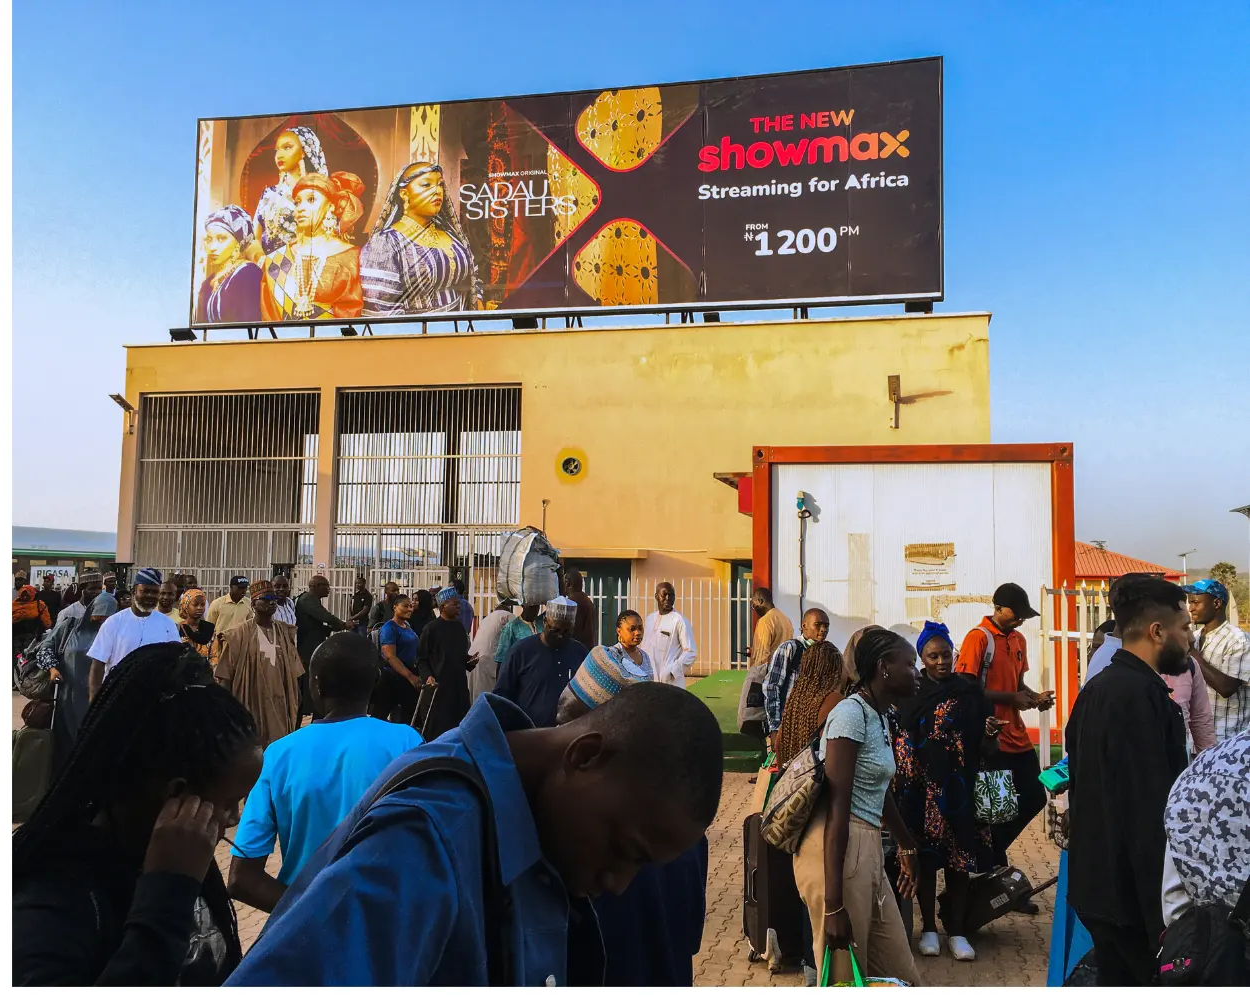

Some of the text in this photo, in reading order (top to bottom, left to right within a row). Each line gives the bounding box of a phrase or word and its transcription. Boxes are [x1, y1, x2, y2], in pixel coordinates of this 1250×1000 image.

[750, 108, 855, 133] THE NEW
[698, 129, 910, 172] showmax
[459, 180, 549, 203] SADAU
[698, 171, 909, 200] Streaming for Africa
[465, 195, 577, 219] SISTERS
[745, 223, 769, 231] FROM
[839, 225, 859, 236] PM
